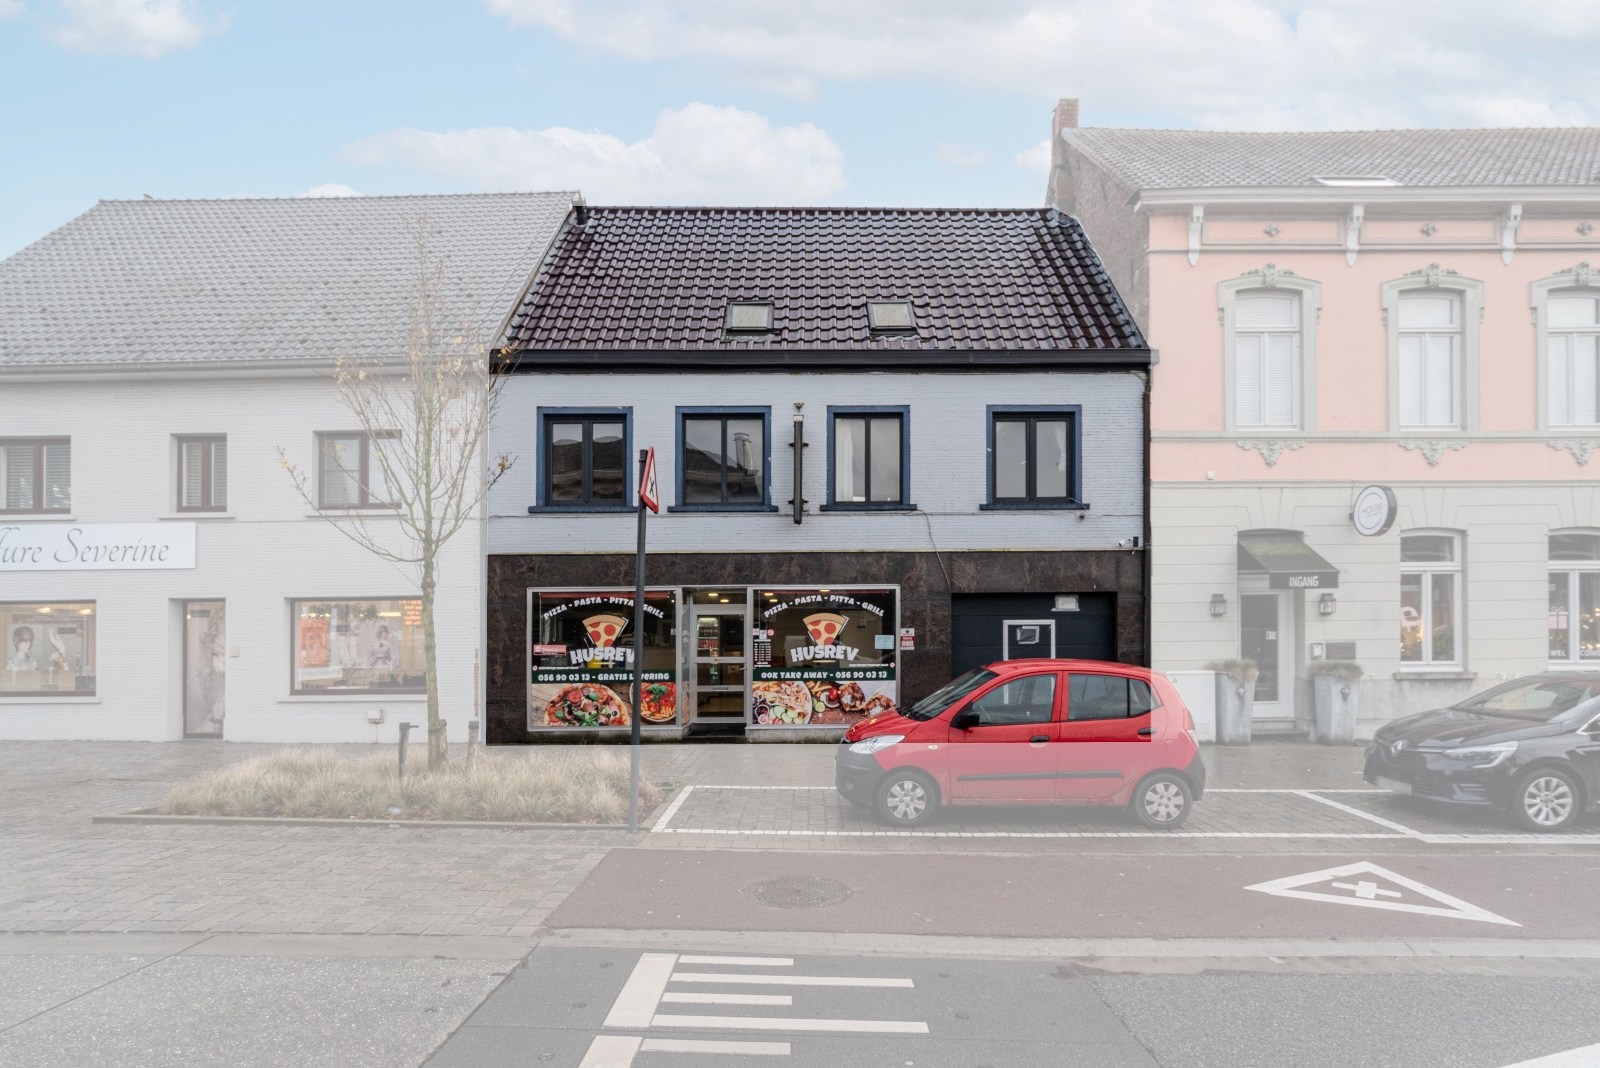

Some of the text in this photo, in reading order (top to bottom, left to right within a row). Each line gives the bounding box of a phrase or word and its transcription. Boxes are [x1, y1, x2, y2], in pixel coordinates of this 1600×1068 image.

[53, 528, 170, 563] Severine
[1289, 576, 1319, 588] INGANG
[543, 603, 567, 620] PIZZA
[574, 597, 602, 607] PASTA
[609, 596, 634, 607] PITTA
[763, 602, 788, 618] PIZZA
[794, 595, 822, 605] PASTA
[829, 594, 855, 605] PITTA
[861, 601, 885, 617] GRILL
[570, 647, 634, 664] HUSREV
[790, 644, 859, 662] HUSREV
[538, 673, 555, 682] 056
[555, 673, 567, 682] 90
[568, 673, 580, 682] 03
[581, 673, 590, 682] 13
[597, 673, 628, 681] GRATIS
[761, 671, 779, 680] OOK
[802, 671, 829, 680] AWAY
[835, 671, 851, 679] 056
[852, 671, 864, 679] 90
[865, 670, 877, 679] 03
[878, 670, 888, 679] 13
